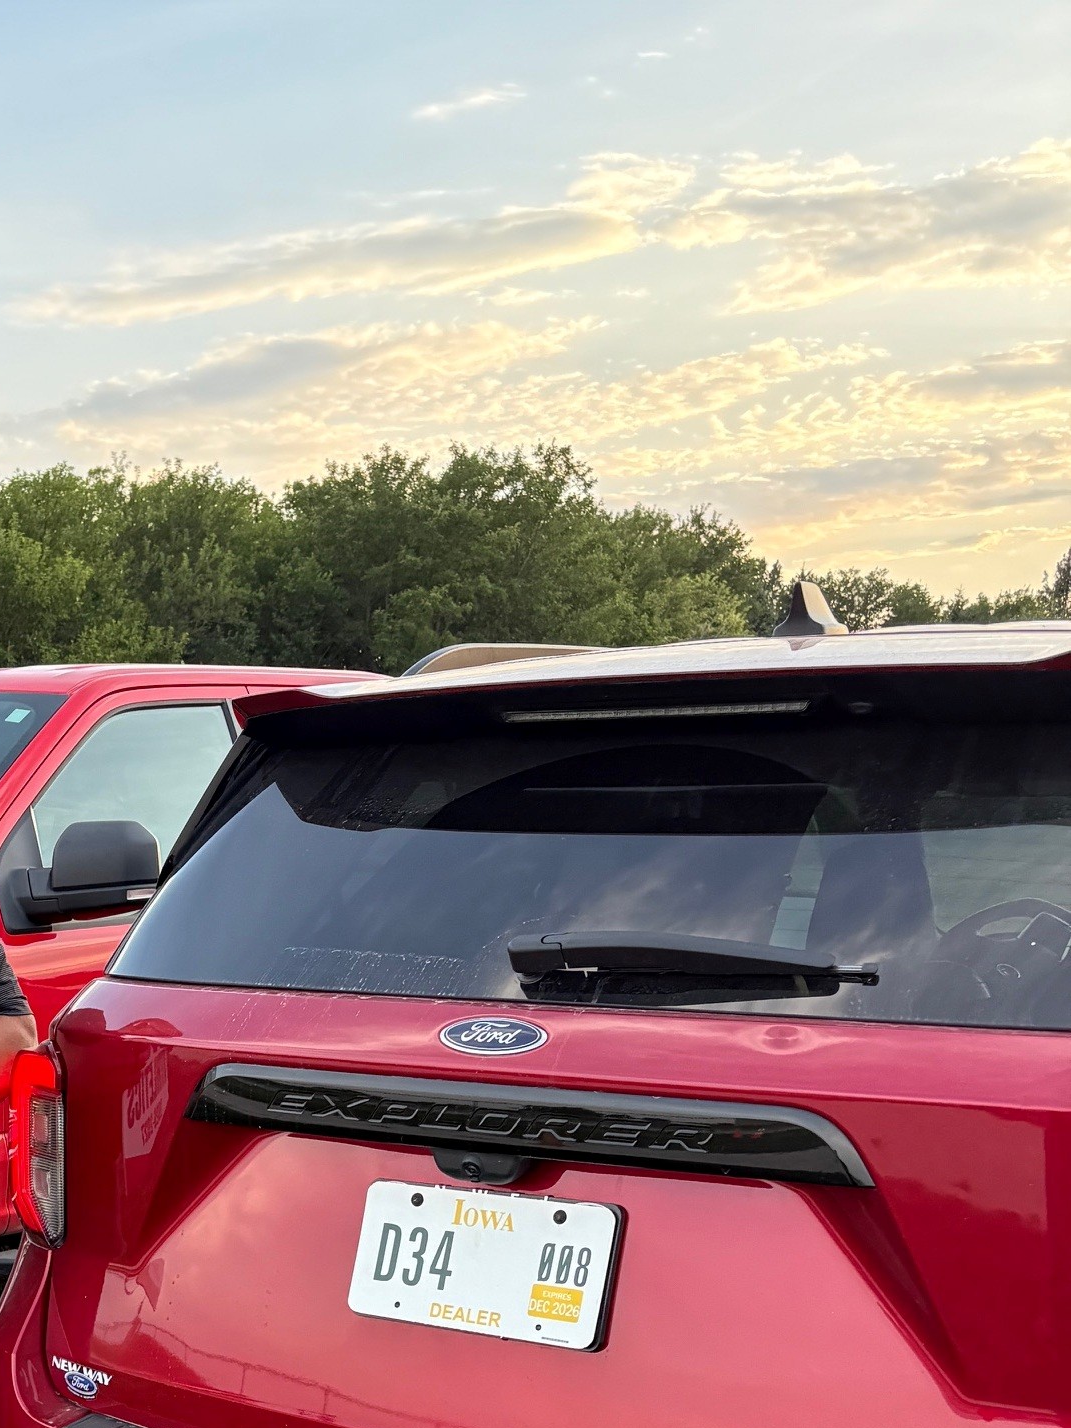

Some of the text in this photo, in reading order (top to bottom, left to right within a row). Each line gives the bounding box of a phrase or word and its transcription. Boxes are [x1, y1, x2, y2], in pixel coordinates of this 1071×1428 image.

[460, 1021, 522, 1045] Ford
[266, 1090, 715, 1153] EXPLORER
[373, 1222, 592, 1291] D34 008
[542, 1290, 572, 1301] EXPIRES
[429, 1302, 502, 1328] DEALER
[529, 1299, 580, 1318] DEC 2026
[51, 1355, 113, 1386] NEW WAY
[71, 1375, 90, 1391] Ford
